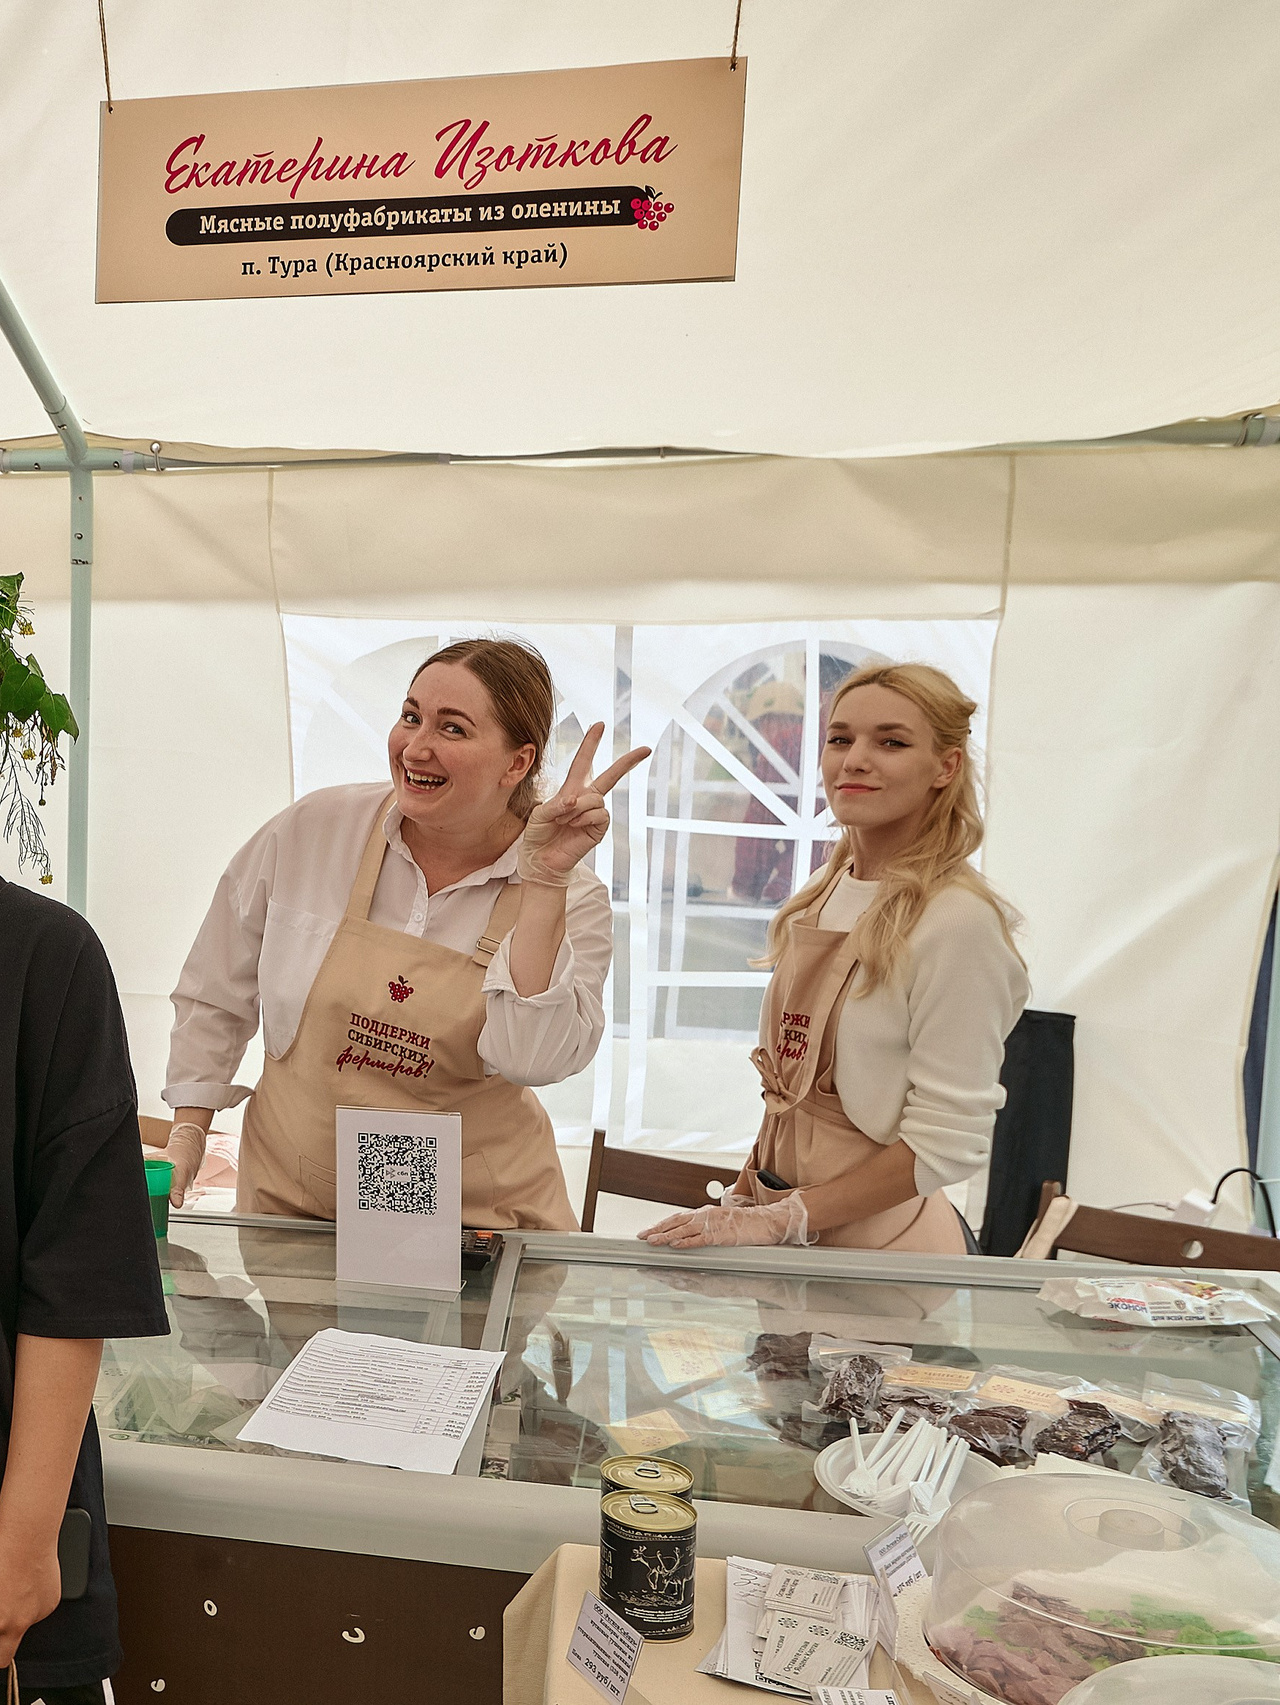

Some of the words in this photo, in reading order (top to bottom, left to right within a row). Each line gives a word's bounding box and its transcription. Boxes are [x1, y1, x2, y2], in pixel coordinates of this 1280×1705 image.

[164, 134, 416, 199] Екатерина
[434, 113, 678, 190] Изоткова
[200, 213, 286, 235] Мясные
[290, 203, 473, 234] полуфабрикаты
[478, 204, 504, 221] из
[511, 198, 621, 220] оленины
[241, 259, 262, 277] п.
[268, 255, 317, 279] Тура
[324, 246, 496, 278] (Красноярский
[502, 242, 568, 270] край)
[348, 1029, 428, 1063] СИБИРСКИХ
[349, 1012, 431, 1050] ПОДДЕРЖИ
[336, 1045, 435, 1078] фермеров!
[1108, 1302, 1148, 1313] ЭКОНОМ
[584, 1658, 596, 1673] 293
